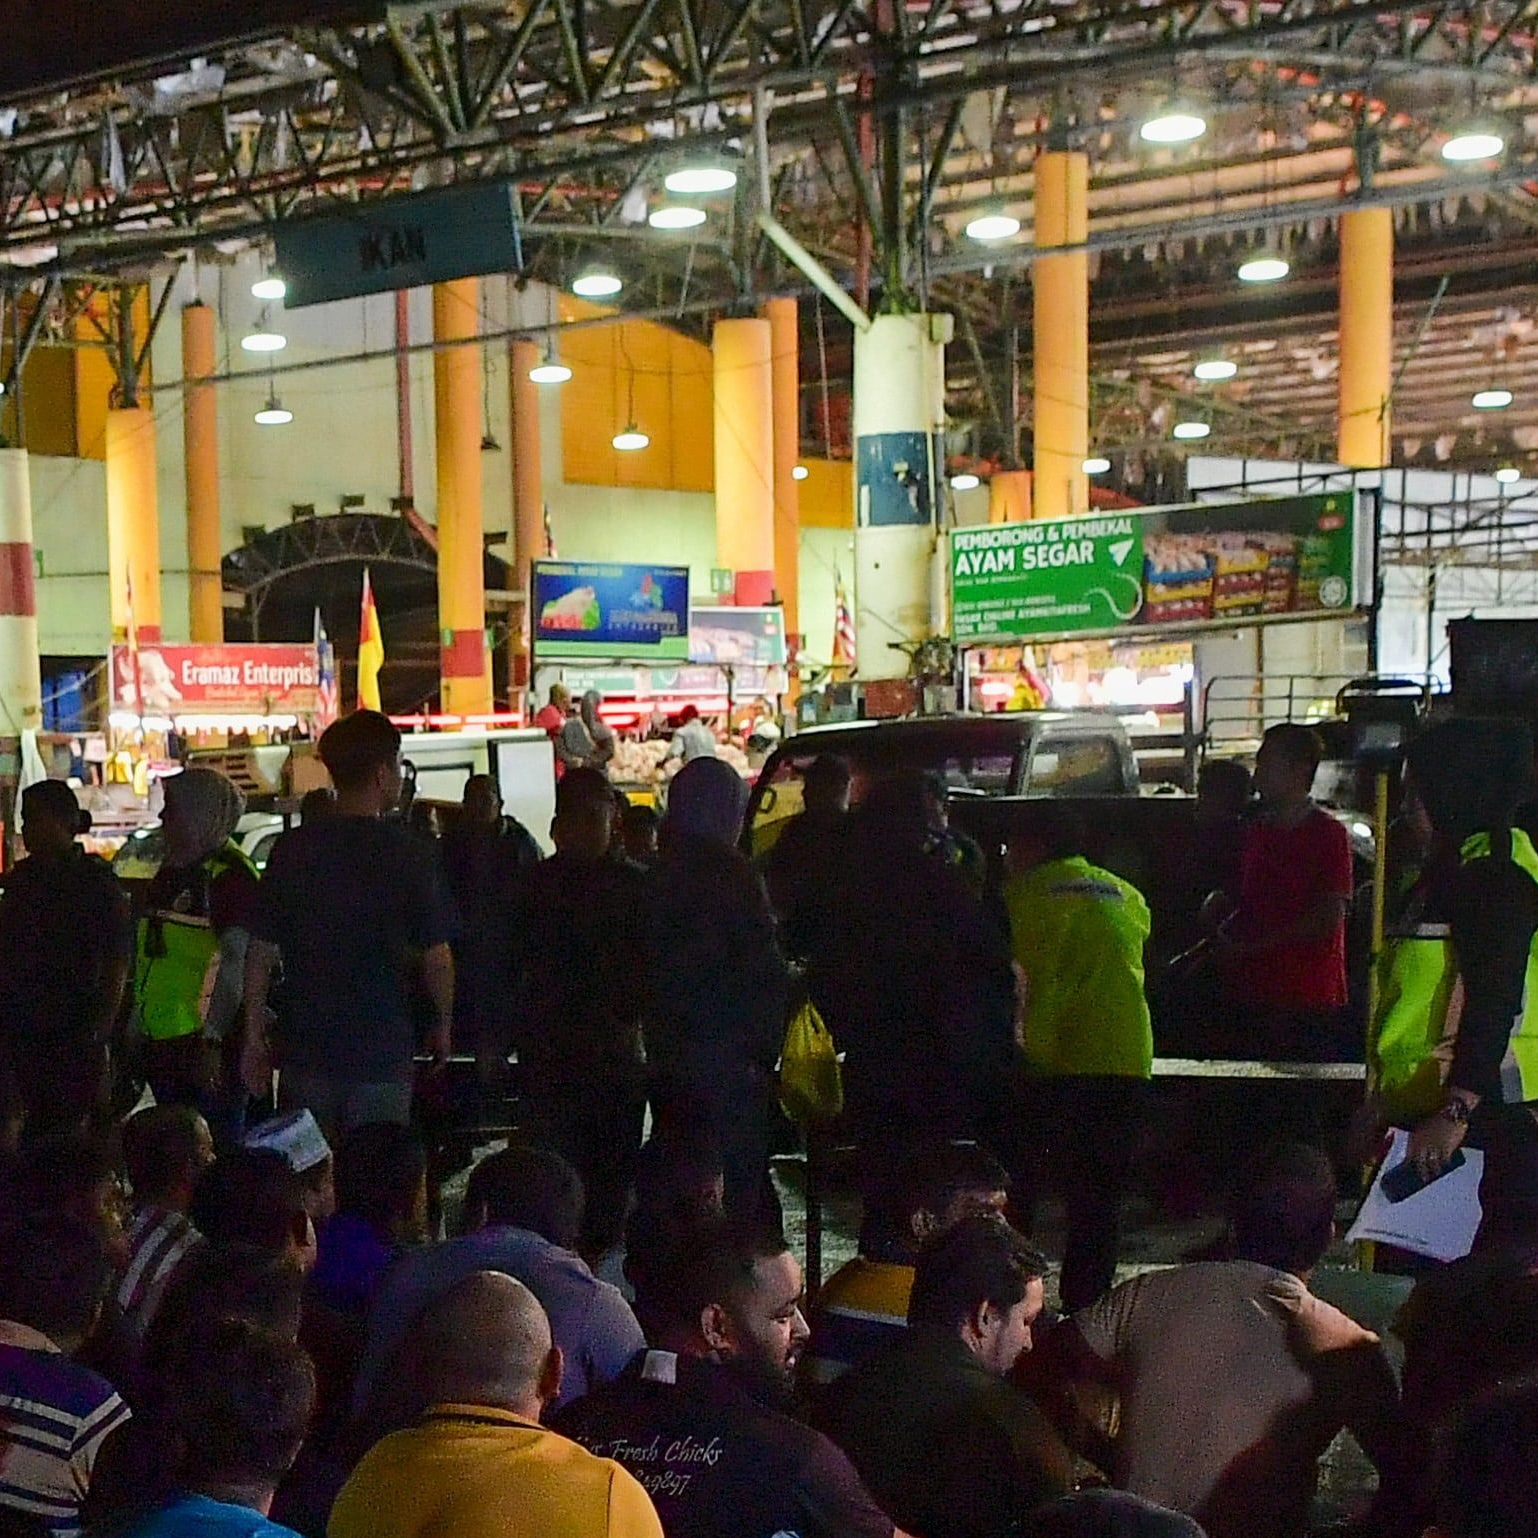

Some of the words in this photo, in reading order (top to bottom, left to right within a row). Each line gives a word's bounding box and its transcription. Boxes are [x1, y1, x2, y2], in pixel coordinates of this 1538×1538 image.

[360, 229, 426, 271] IKAN
[956, 527, 1045, 551] PEMBORONG
[1047, 527, 1060, 541] &
[1062, 518, 1134, 540] PEMBEKAL
[955, 552, 1016, 577] AYAM
[1022, 541, 1095, 570] SEGAR
[182, 660, 240, 685] Eramaz
[243, 660, 320, 690] Enterpris
[610, 1435, 661, 1461] Fresh
[664, 1435, 723, 1467] Chicks
